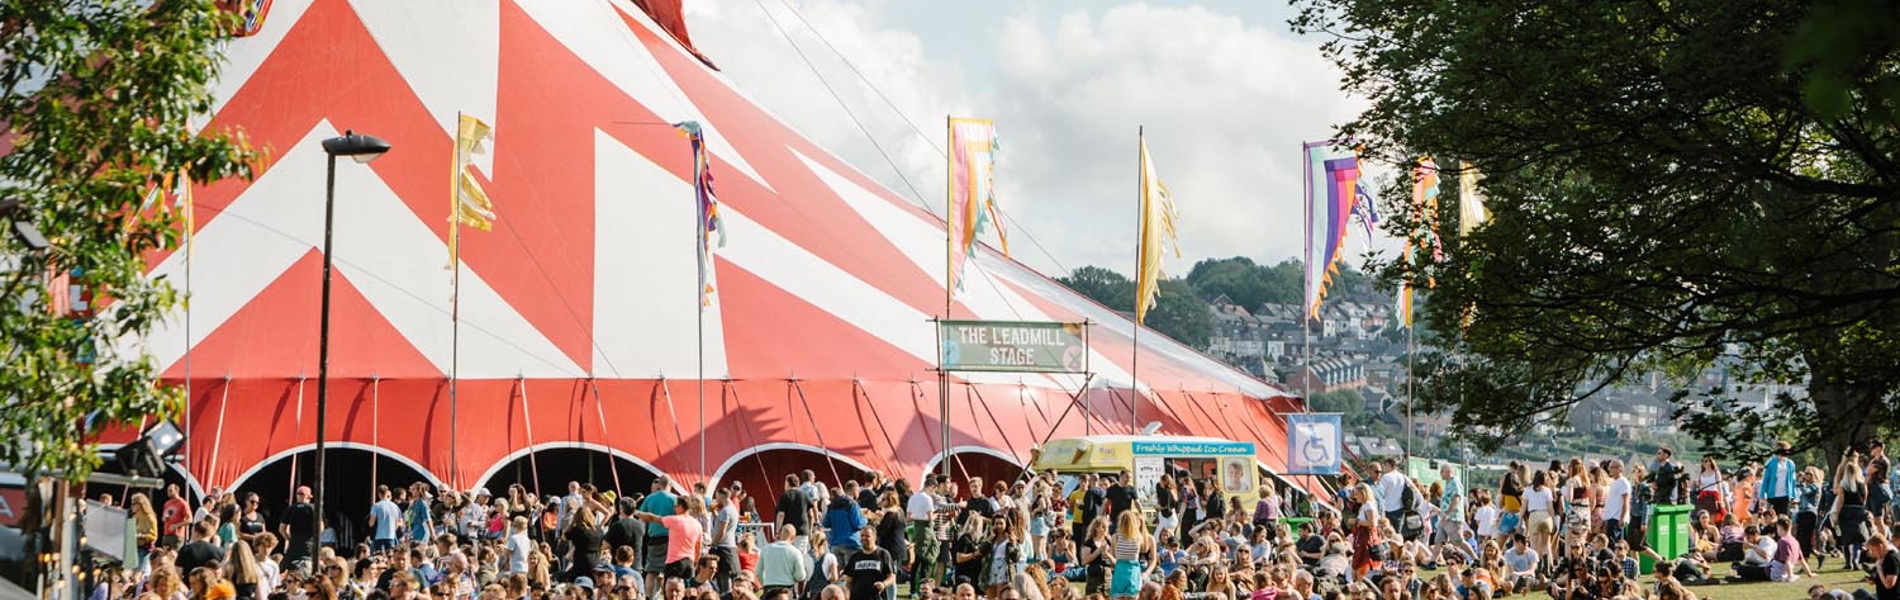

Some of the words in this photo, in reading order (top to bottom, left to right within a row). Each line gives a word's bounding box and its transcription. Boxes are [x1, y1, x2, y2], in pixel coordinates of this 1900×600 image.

[958, 327, 987, 344] THE
[993, 328, 1065, 346] LEADMILL
[990, 347, 1035, 365] STAGE
[1135, 443, 1165, 454] Freshly
[1167, 444, 1203, 455] Whipped
[1204, 445, 1217, 453] Ice
